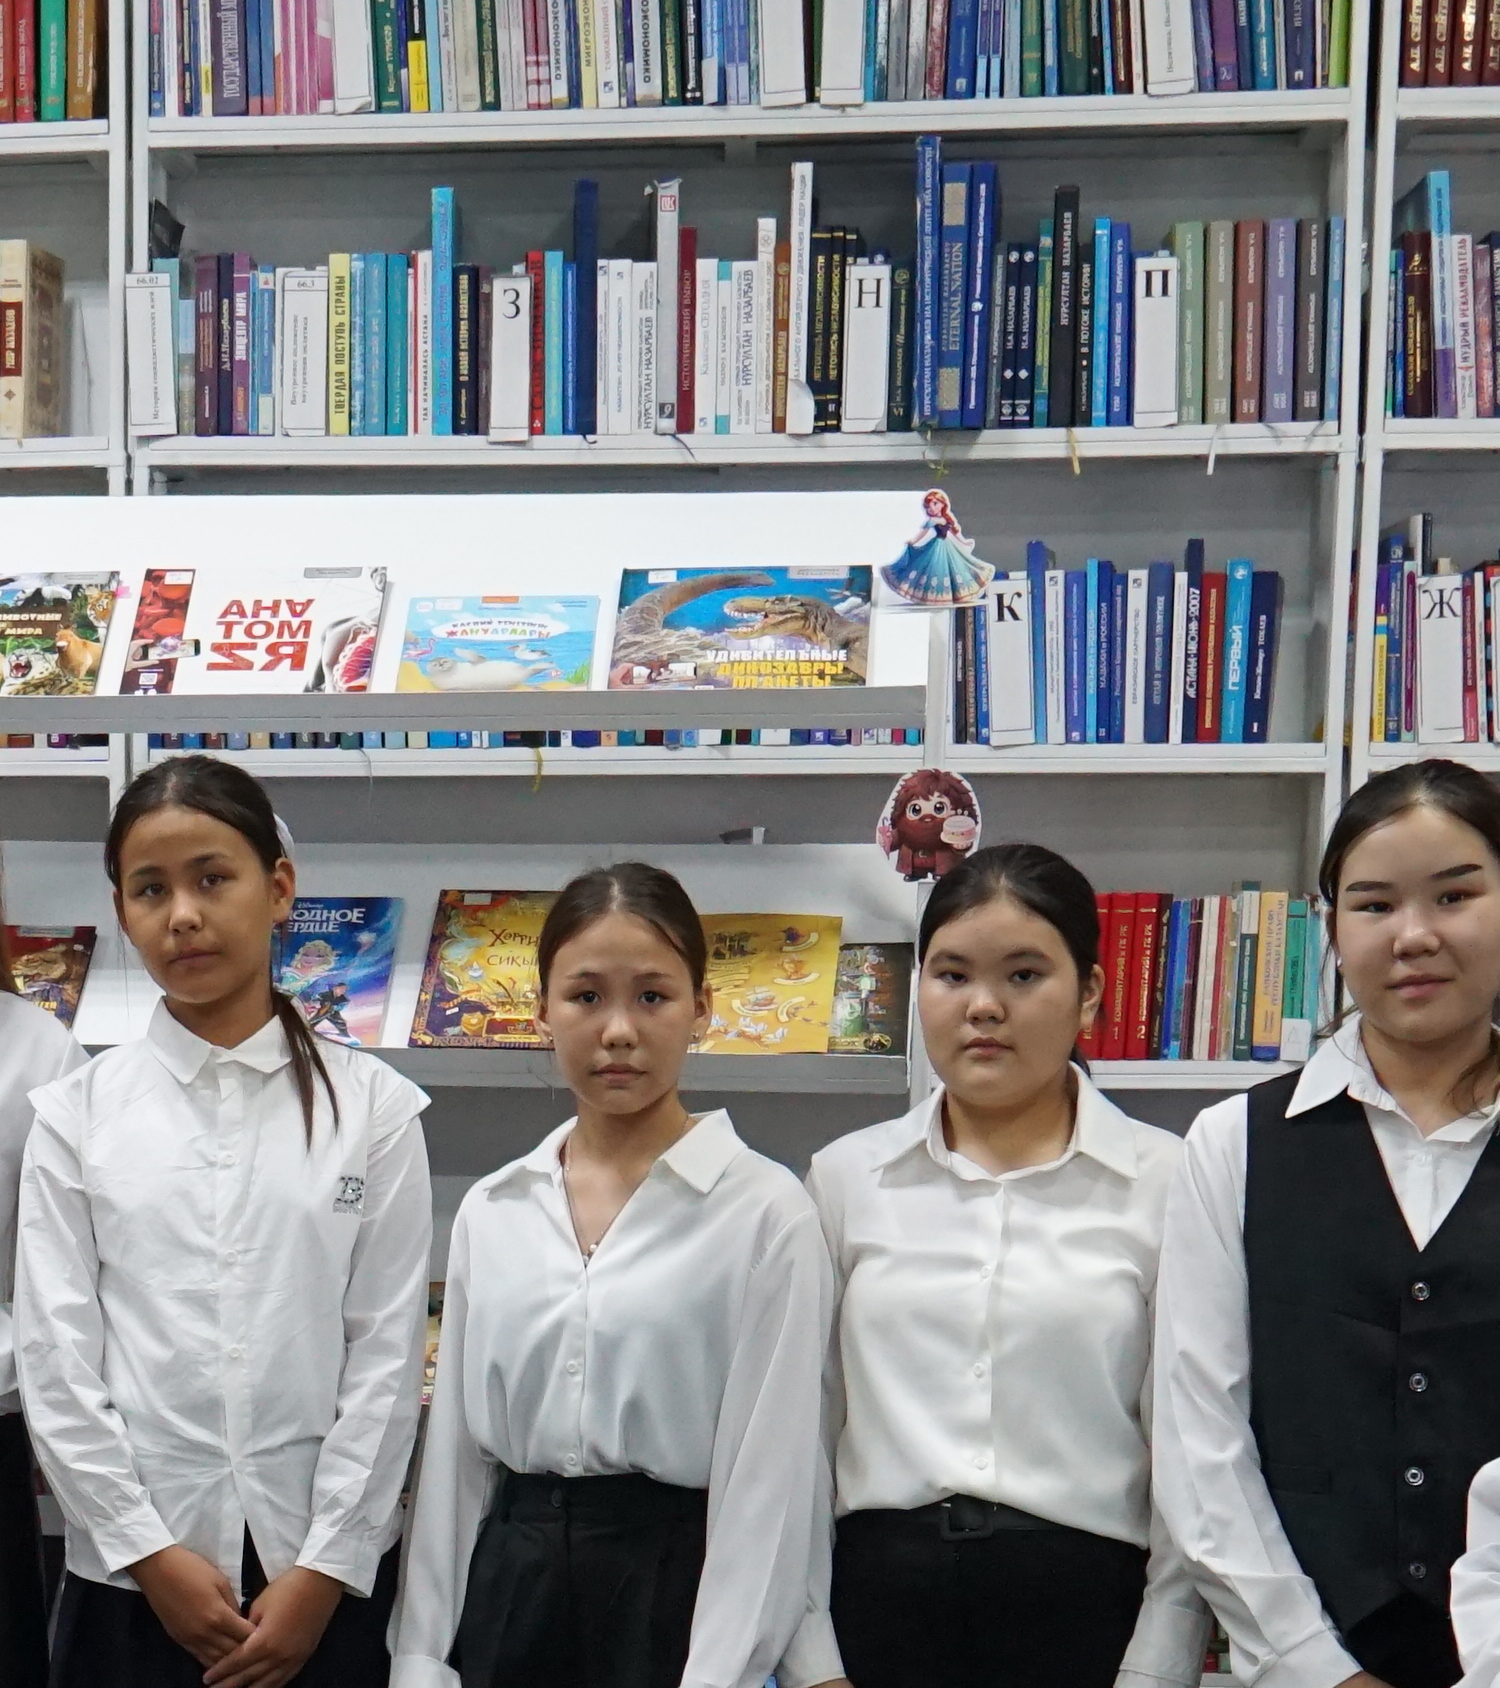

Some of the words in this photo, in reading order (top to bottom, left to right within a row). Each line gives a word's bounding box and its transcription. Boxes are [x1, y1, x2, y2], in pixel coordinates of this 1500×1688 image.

[1061, 212, 1072, 266] НАЗАРБАЕВ
[951, 242, 963, 291] NATION
[1142, 270, 1171, 298] П
[234, 292, 246, 316] МИРА
[334, 276, 345, 315] СТРАНЫ
[743, 270, 753, 324] НАЗАРБАЕВ
[855, 279, 882, 308] Н
[1060, 272, 1070, 326] НУРСУЛТАН
[949, 293, 961, 351] ETERNAL
[1081, 309, 1090, 343] ПОТОКЕ
[1459, 322, 1470, 363] МУДРЫЙ
[334, 322, 345, 365] ПОСТУПЬ
[644, 317, 653, 370] НАЗАРБАЕВ
[742, 331, 753, 386] НУРСУЛТАН
[334, 372, 346, 414] ТВЕРДАЯ
[644, 373, 653, 429] НУРСУЛТАН
[993, 593, 1022, 622] К
[1422, 588, 1461, 620] Ж
[216, 620, 313, 640] ТОМ
[705, 649, 847, 663] УДИВИТЕЛЬНЫЕ
[717, 662, 844, 676] ДИНОЗАВРЫ
[1228, 625, 1243, 690] ПЕРВЫЙ
[732, 674, 832, 688] ПЛАНЕТЫ
